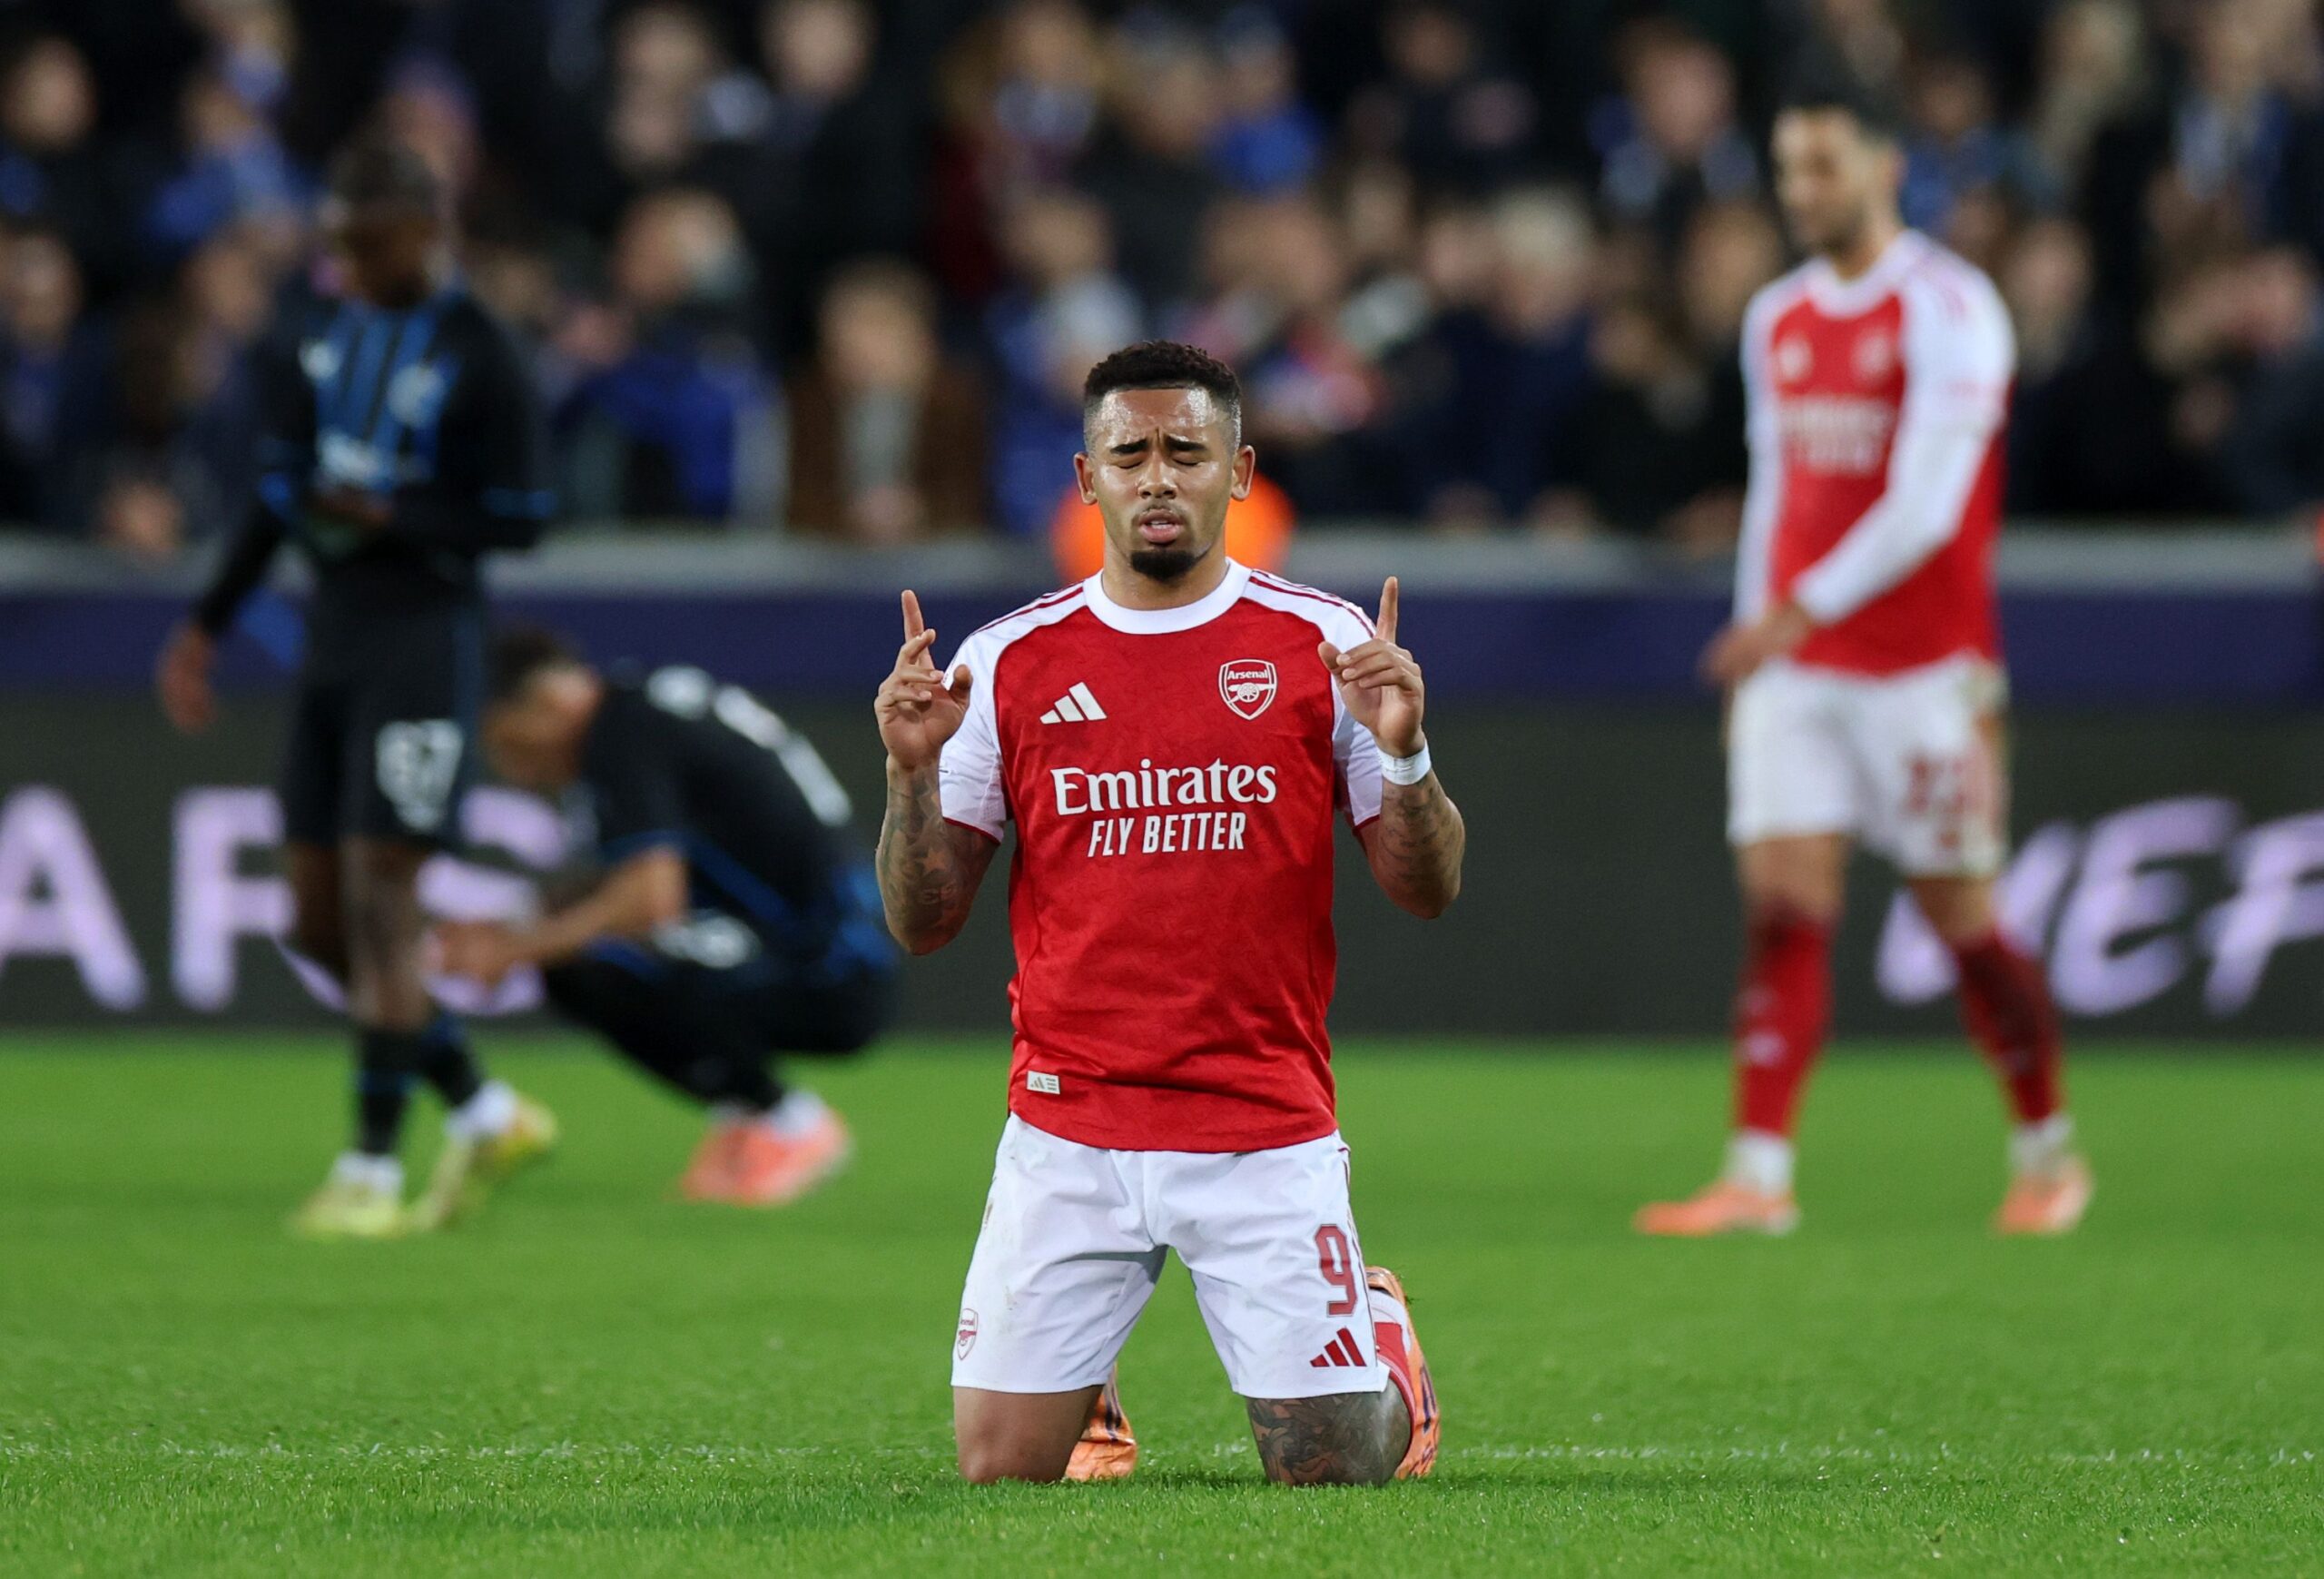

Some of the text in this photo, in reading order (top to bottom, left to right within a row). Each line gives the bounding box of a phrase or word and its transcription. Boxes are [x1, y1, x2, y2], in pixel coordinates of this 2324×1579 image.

[1227, 669, 1268, 680] Arsenal
[1050, 757, 1276, 815] Emirates
[1088, 812, 1246, 857] FLY BETTER
[1314, 1223, 1358, 1317] 9
